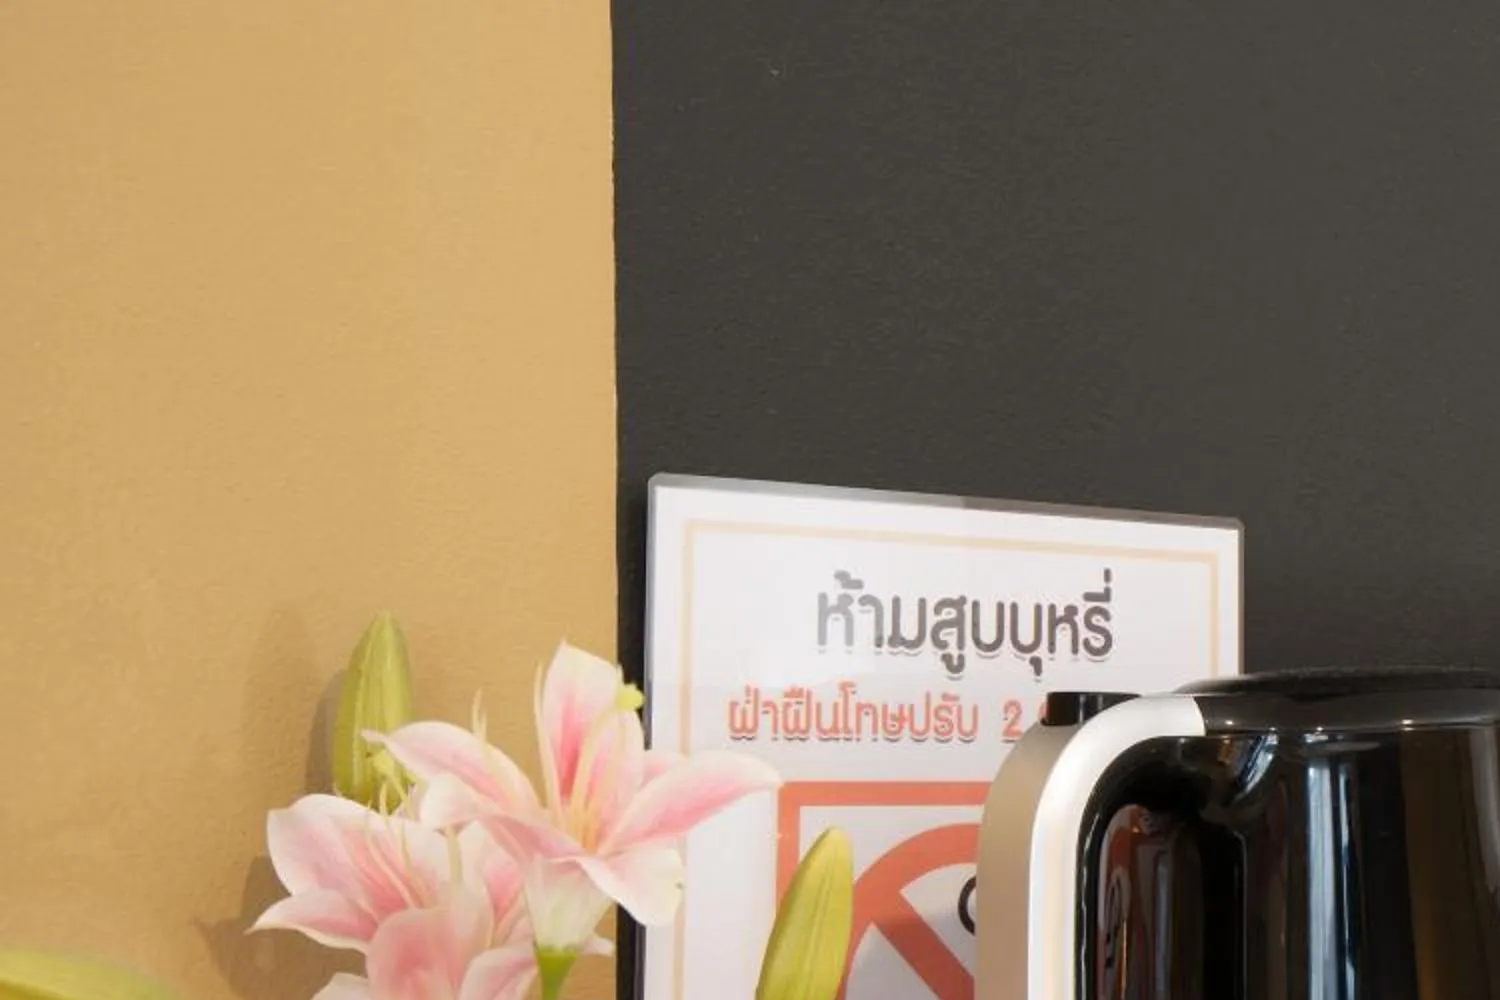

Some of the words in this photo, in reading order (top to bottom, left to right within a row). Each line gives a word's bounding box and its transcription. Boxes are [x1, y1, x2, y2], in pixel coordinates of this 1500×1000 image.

[816, 567, 1114, 679] ห้ามสูบบุหรี่
[728, 680, 980, 743] ฝ่าฝืนโทษปรับ
